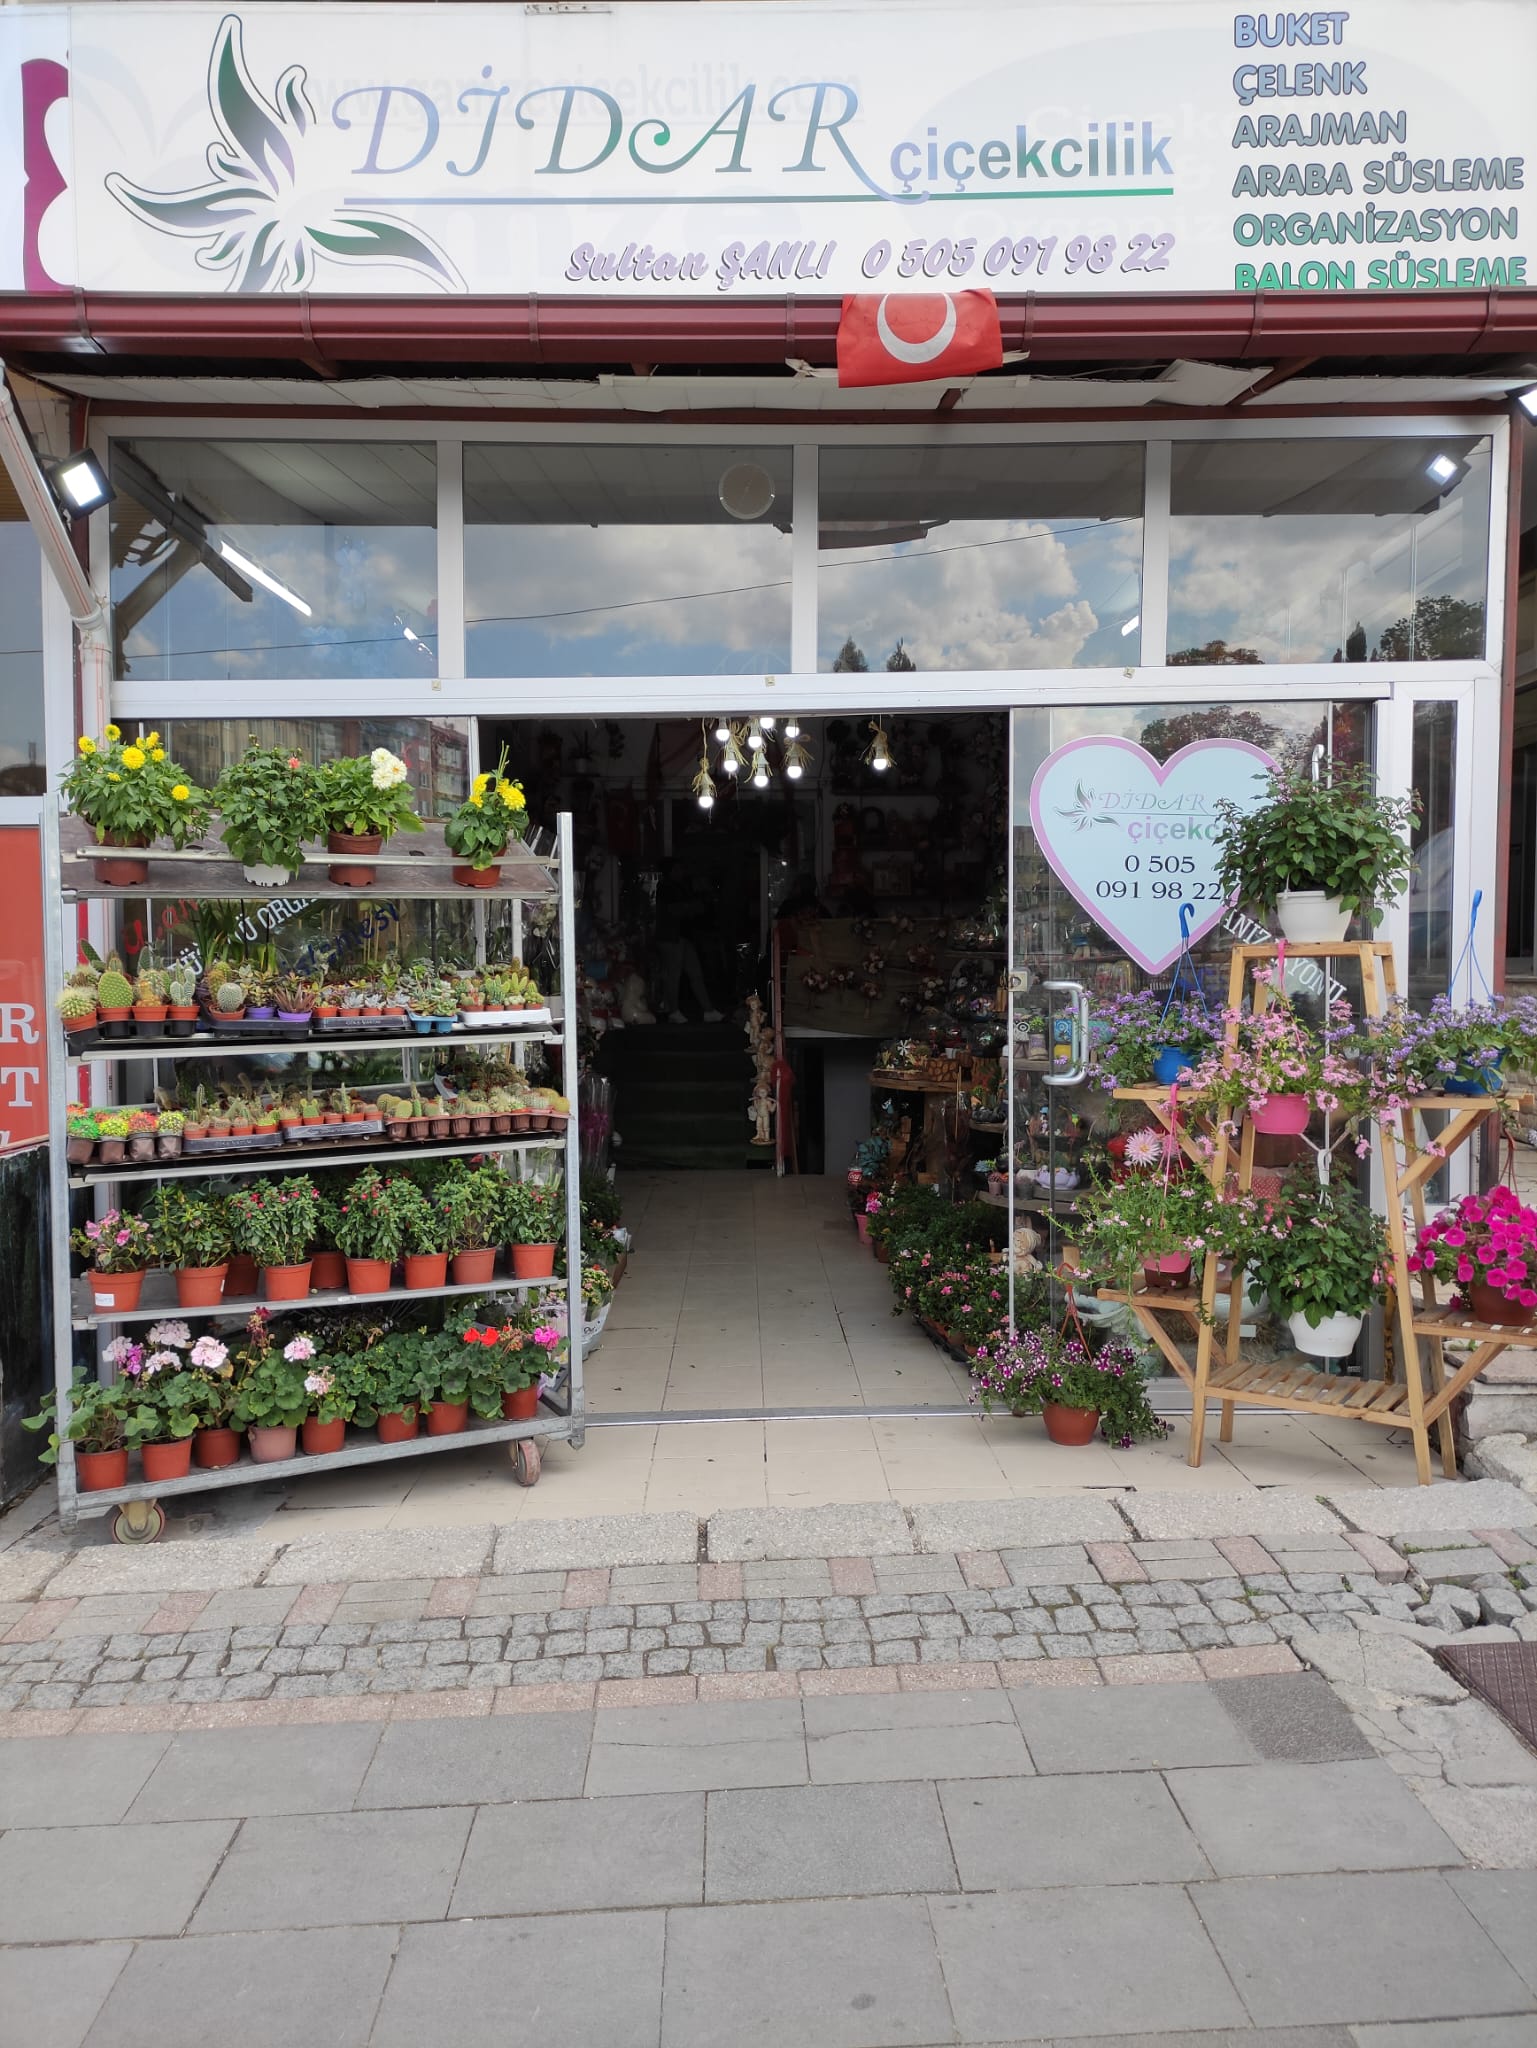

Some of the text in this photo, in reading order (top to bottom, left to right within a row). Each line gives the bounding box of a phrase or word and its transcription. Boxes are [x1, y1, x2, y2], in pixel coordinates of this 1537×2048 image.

[1234, 12, 1350, 47] BUKET
[1233, 61, 1368, 106] ÇELENK
[1232, 110, 1407, 148] ARAJMAN
[890, 121, 1174, 193] çiçekcilik
[1232, 162, 1353, 198] ARABA
[1363, 151, 1525, 194] SÜSLEME
[1233, 202, 1518, 247] ORGANİZASYON
[565, 233, 1176, 291] Sultan ŞANLI 0 505 091 98 22
[1235, 251, 1527, 291] BALON SÜSLEME
[1127, 816, 1220, 844] çiçekc
[1125, 855, 1196, 873] 0 505
[1096, 880, 1222, 900] 091 98 22
